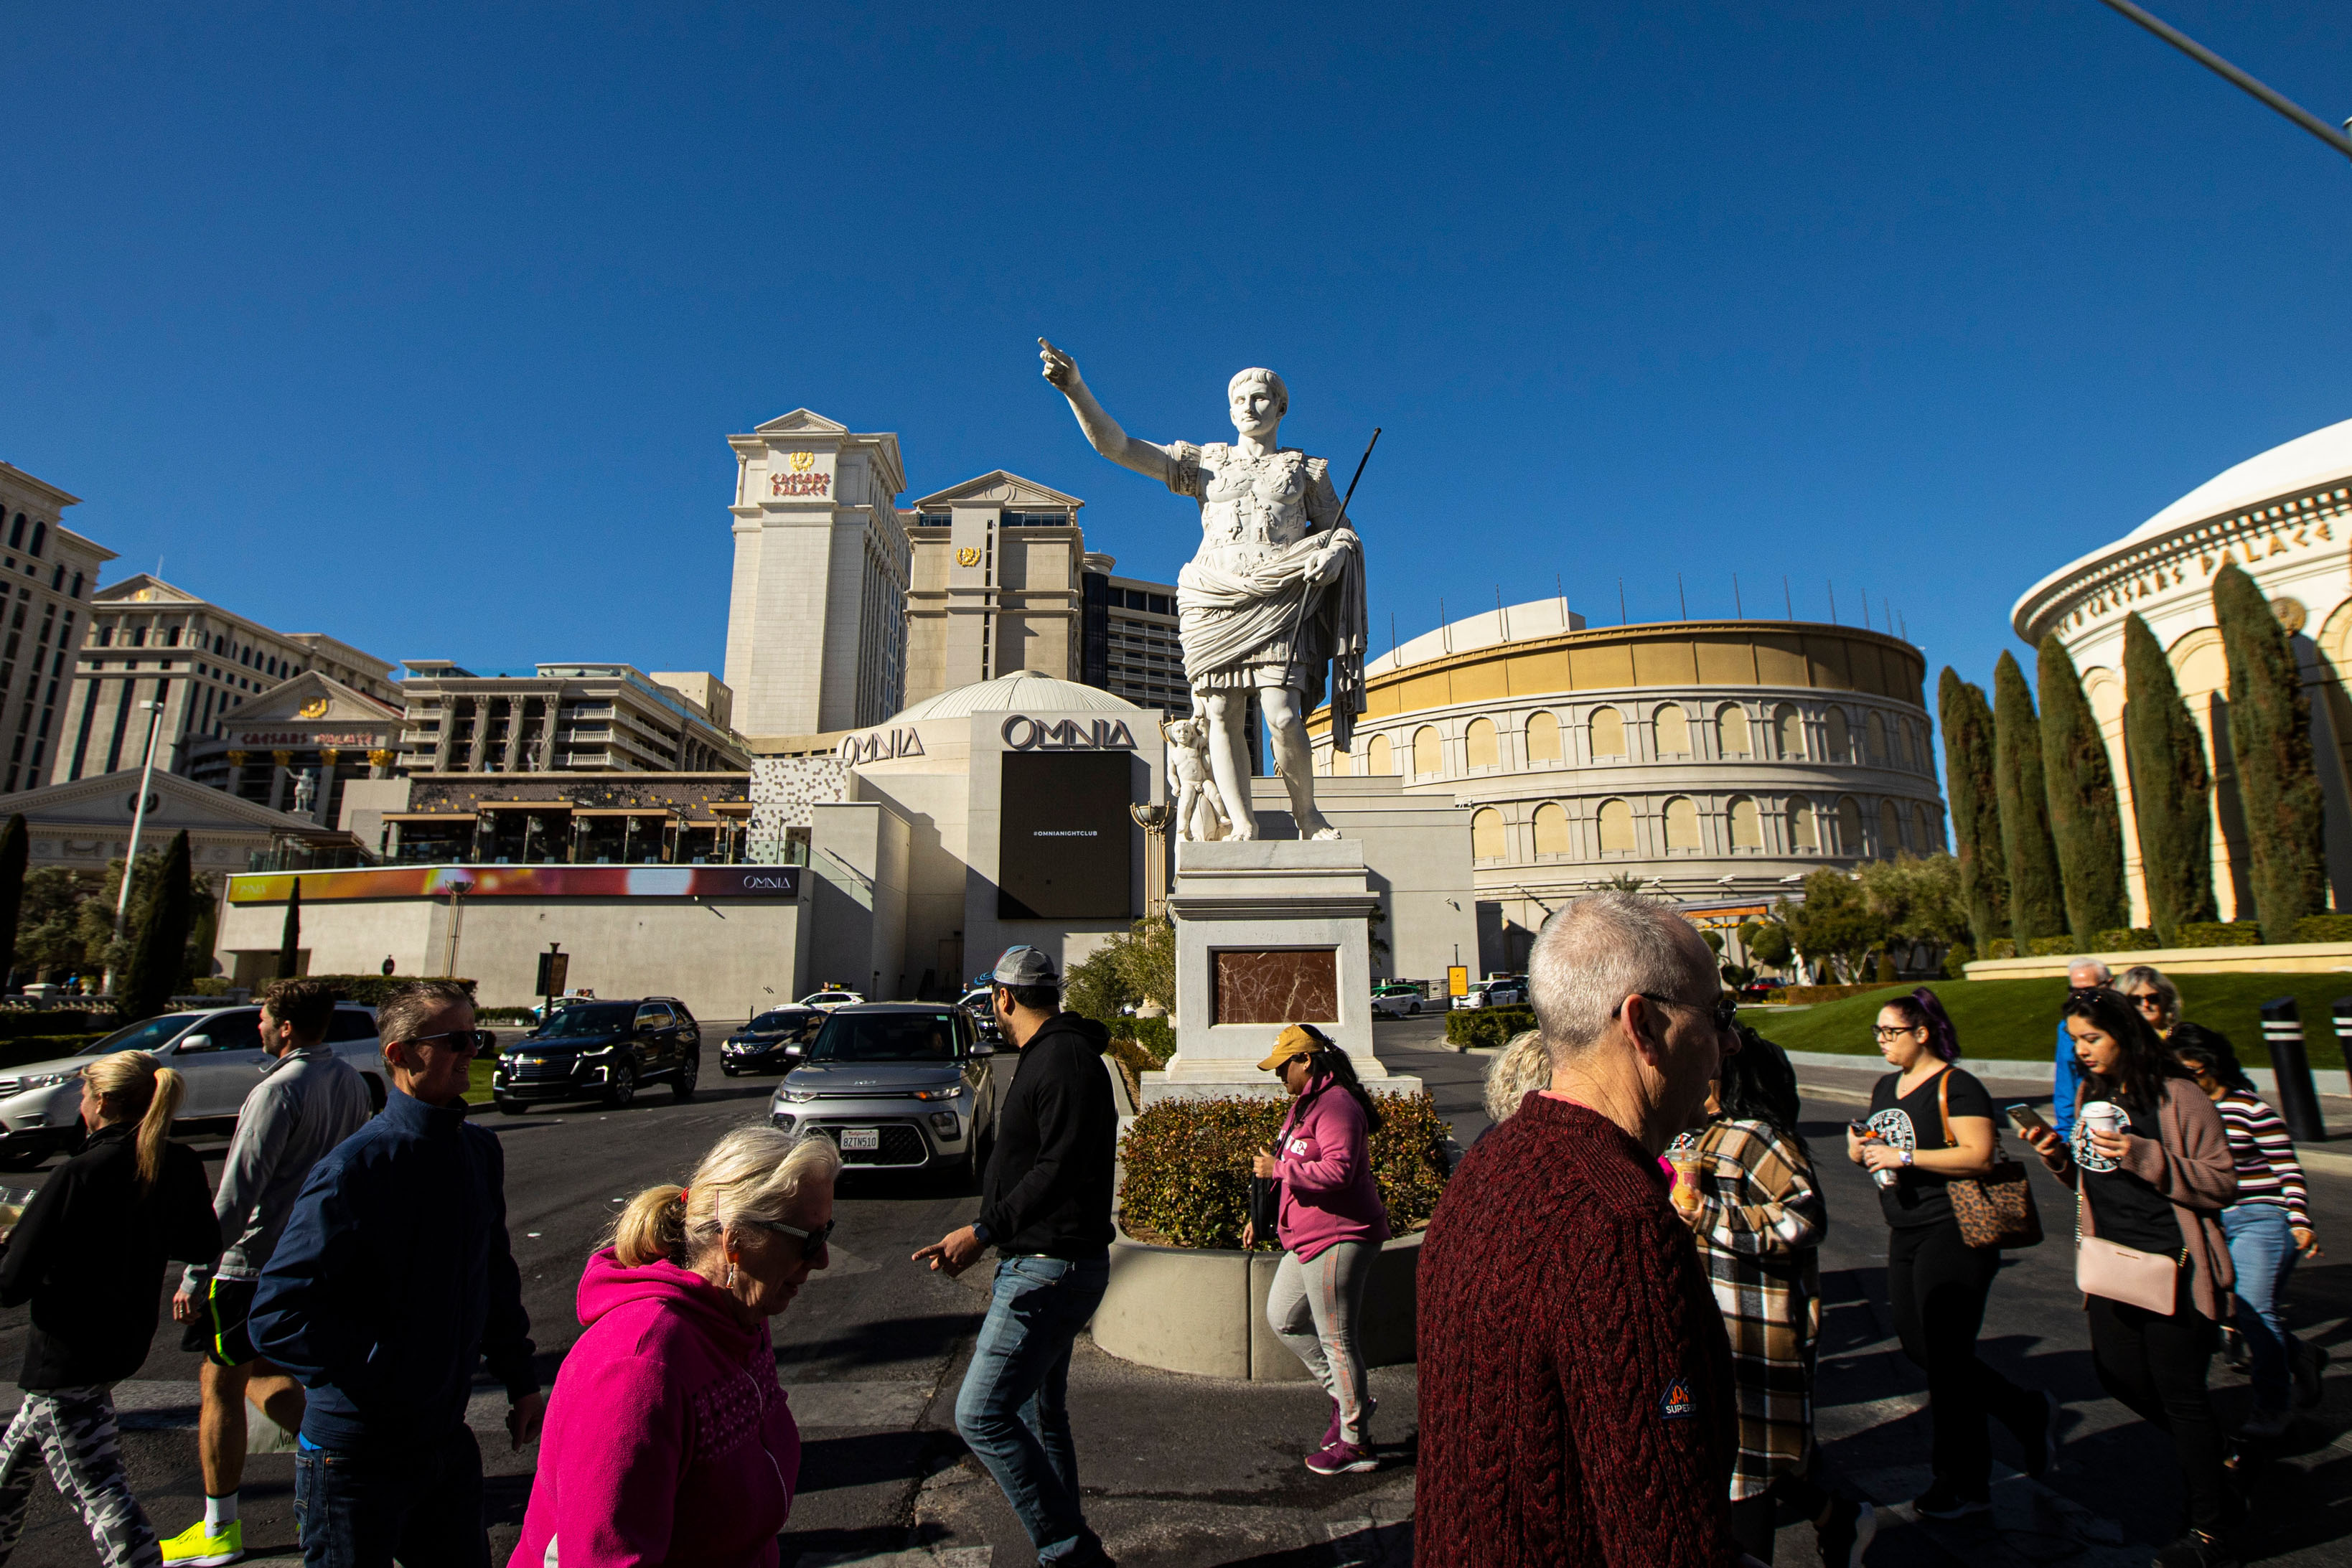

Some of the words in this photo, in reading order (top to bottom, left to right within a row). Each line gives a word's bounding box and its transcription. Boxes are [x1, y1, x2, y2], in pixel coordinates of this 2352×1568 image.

[771, 473, 831, 484] CAESARS
[772, 484, 827, 497] PALACE
[240, 733, 309, 744] CAESARS
[1001, 715, 1135, 750] OMNIA
[842, 726, 926, 769] OMNIA
[744, 875, 791, 888] OMNIA
[843, 1137, 876, 1147] 8ZTN510
